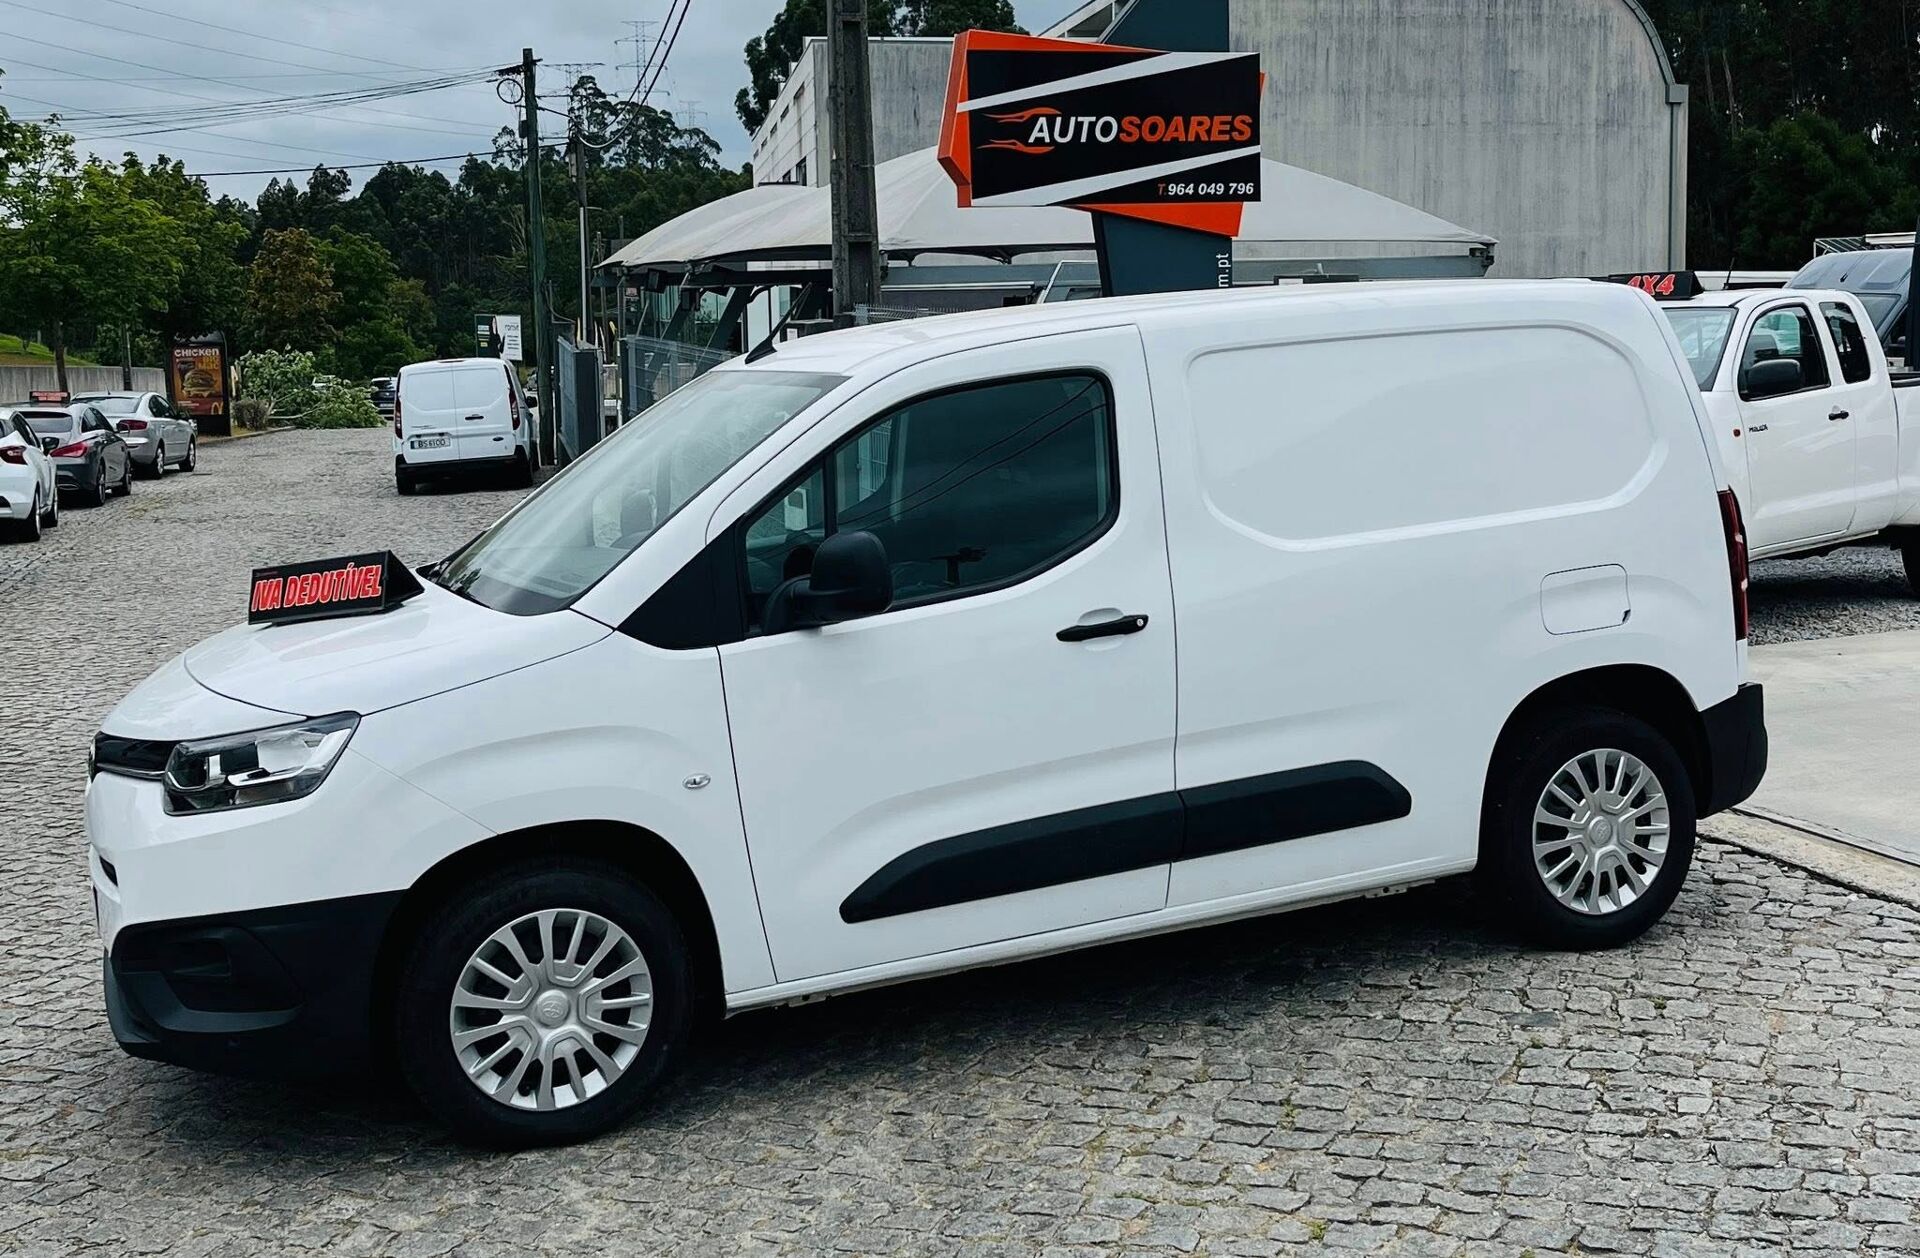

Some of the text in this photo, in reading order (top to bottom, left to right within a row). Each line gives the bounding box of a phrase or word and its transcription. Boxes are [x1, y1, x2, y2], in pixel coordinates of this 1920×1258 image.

[1198, 183, 1224, 195] 049
[1228, 182, 1254, 195] 796
[251, 562, 382, 611] IVA DEDUTÍVEL
